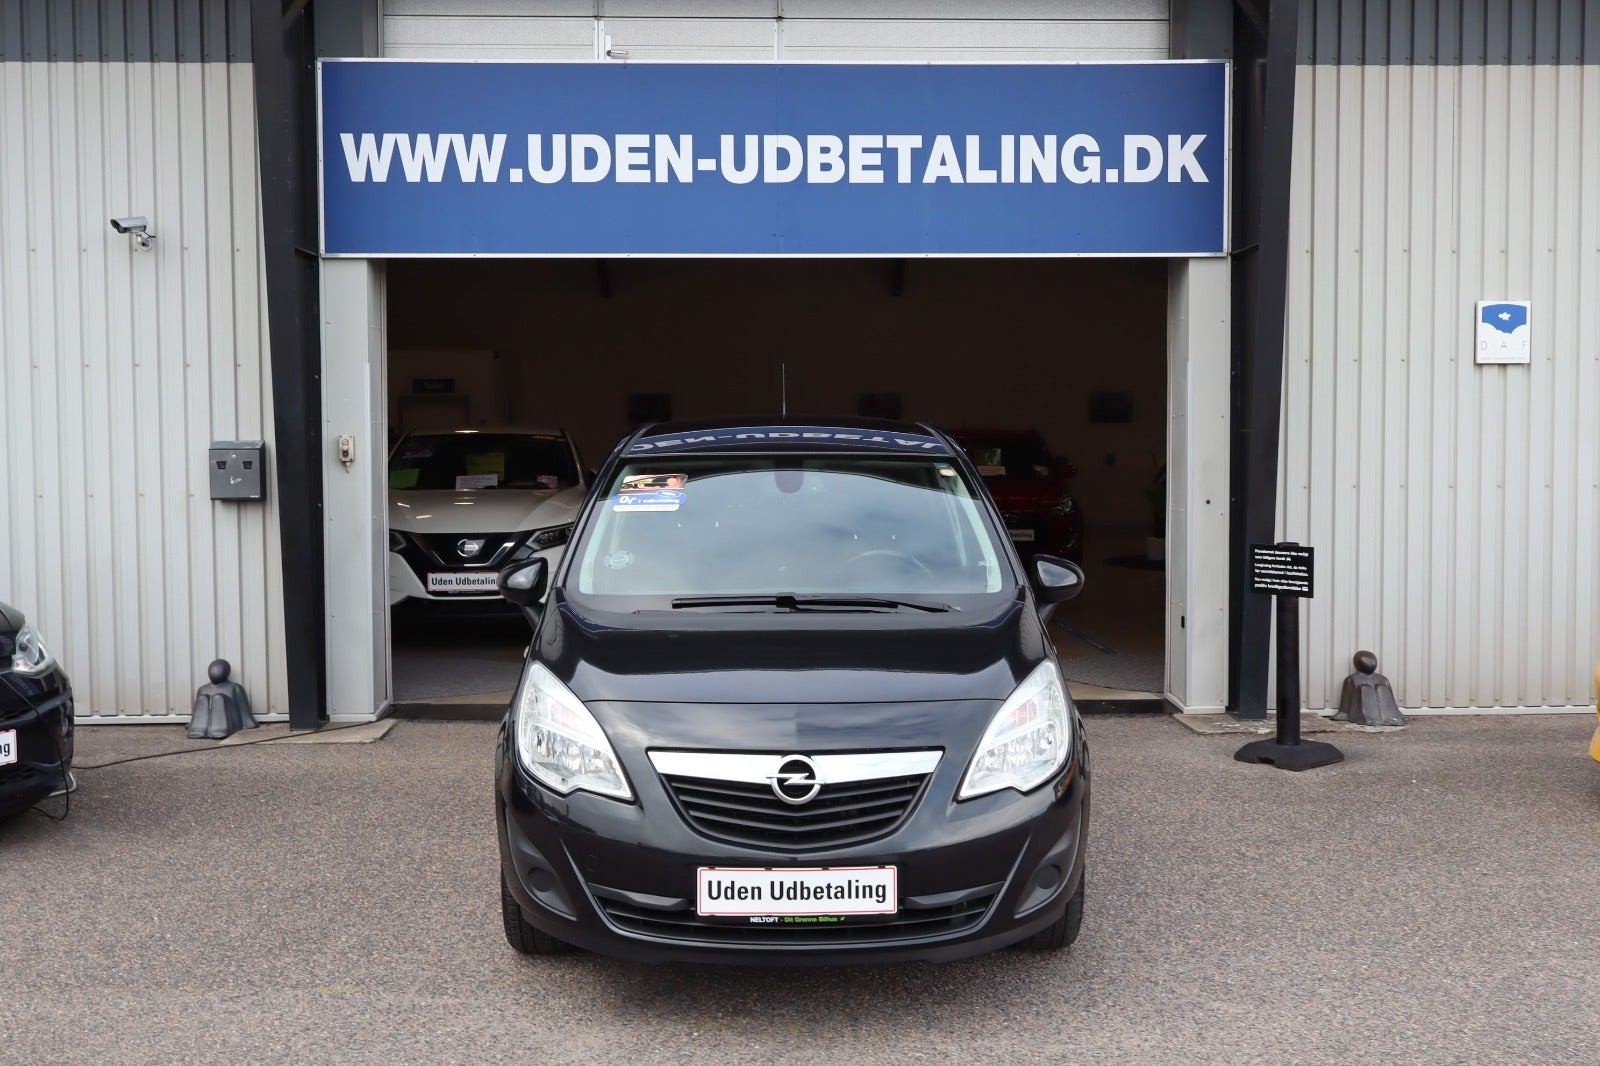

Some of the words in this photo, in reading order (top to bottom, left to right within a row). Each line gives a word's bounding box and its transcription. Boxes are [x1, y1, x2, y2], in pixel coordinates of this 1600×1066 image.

[340, 132, 1209, 185] WWW.UDEN-UDBETALING.DK
[431, 577, 453, 586] Uden
[455, 577, 497, 586] Udbetalin
[707, 880, 762, 901] Uden
[770, 879, 886, 904] Udbetaling
